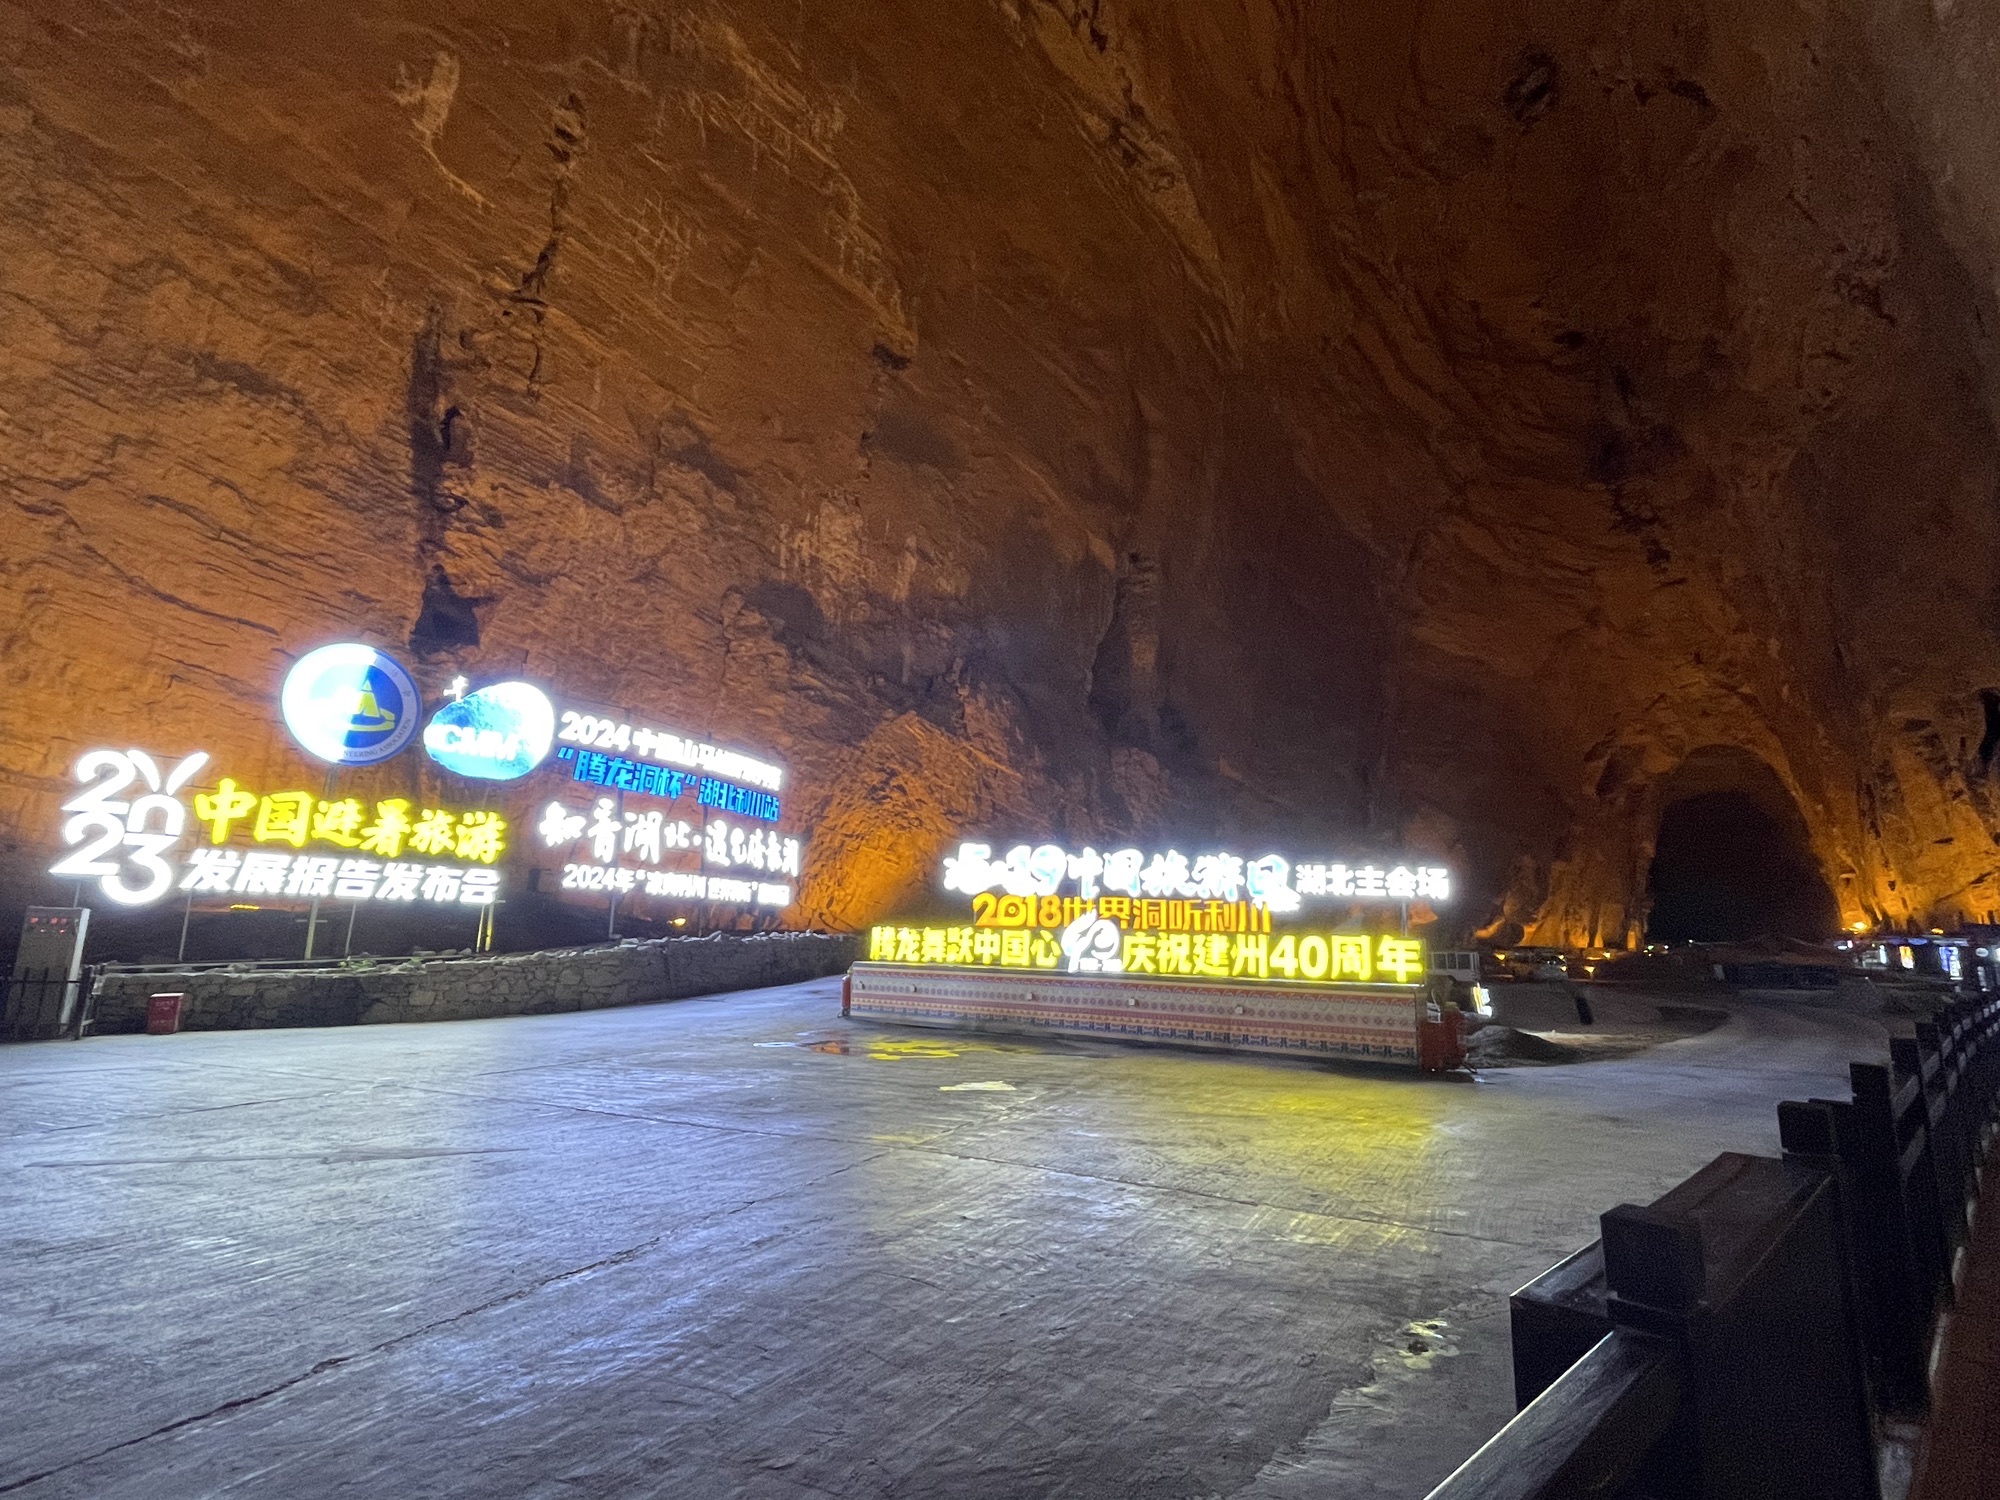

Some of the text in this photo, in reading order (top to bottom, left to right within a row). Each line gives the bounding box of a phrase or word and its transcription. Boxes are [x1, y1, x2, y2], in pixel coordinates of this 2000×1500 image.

[193, 778, 507, 864] 中国避暑旅游
[179, 849, 500, 903] 发展报告发布会
[1296, 864, 1450, 899] 湖北主会场
[869, 926, 1062, 968] 腾龙舞跃中国心
[1122, 931, 1424, 983] 庆祝建州40周年
